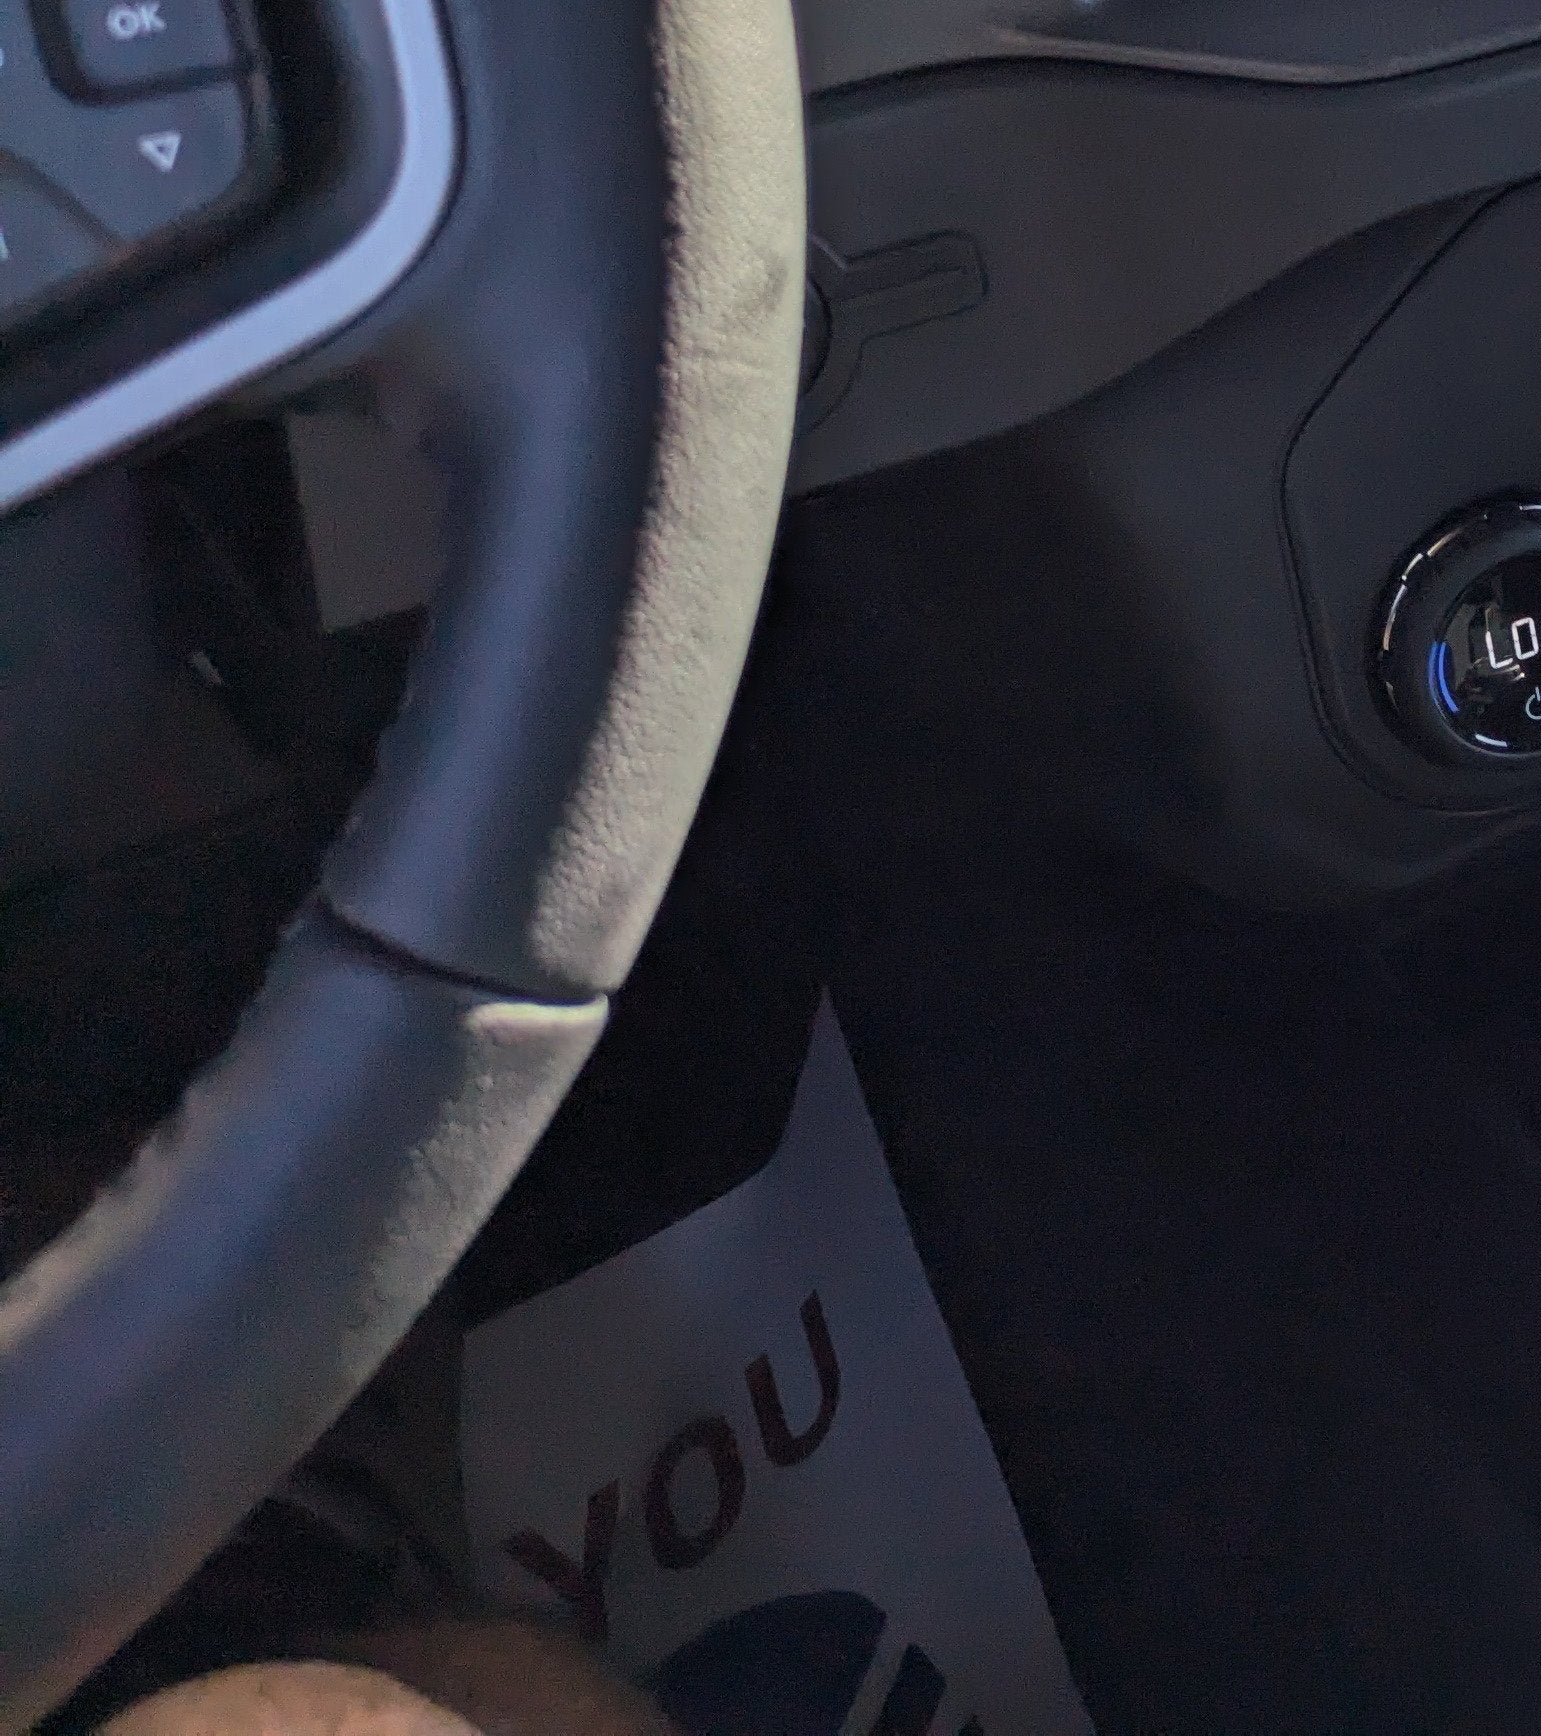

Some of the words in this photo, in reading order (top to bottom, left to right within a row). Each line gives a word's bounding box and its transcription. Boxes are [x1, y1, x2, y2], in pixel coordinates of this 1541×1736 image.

[107, 2, 166, 40] OK
[1486, 617, 1540, 670] LO
[503, 1289, 842, 1640] YOU
